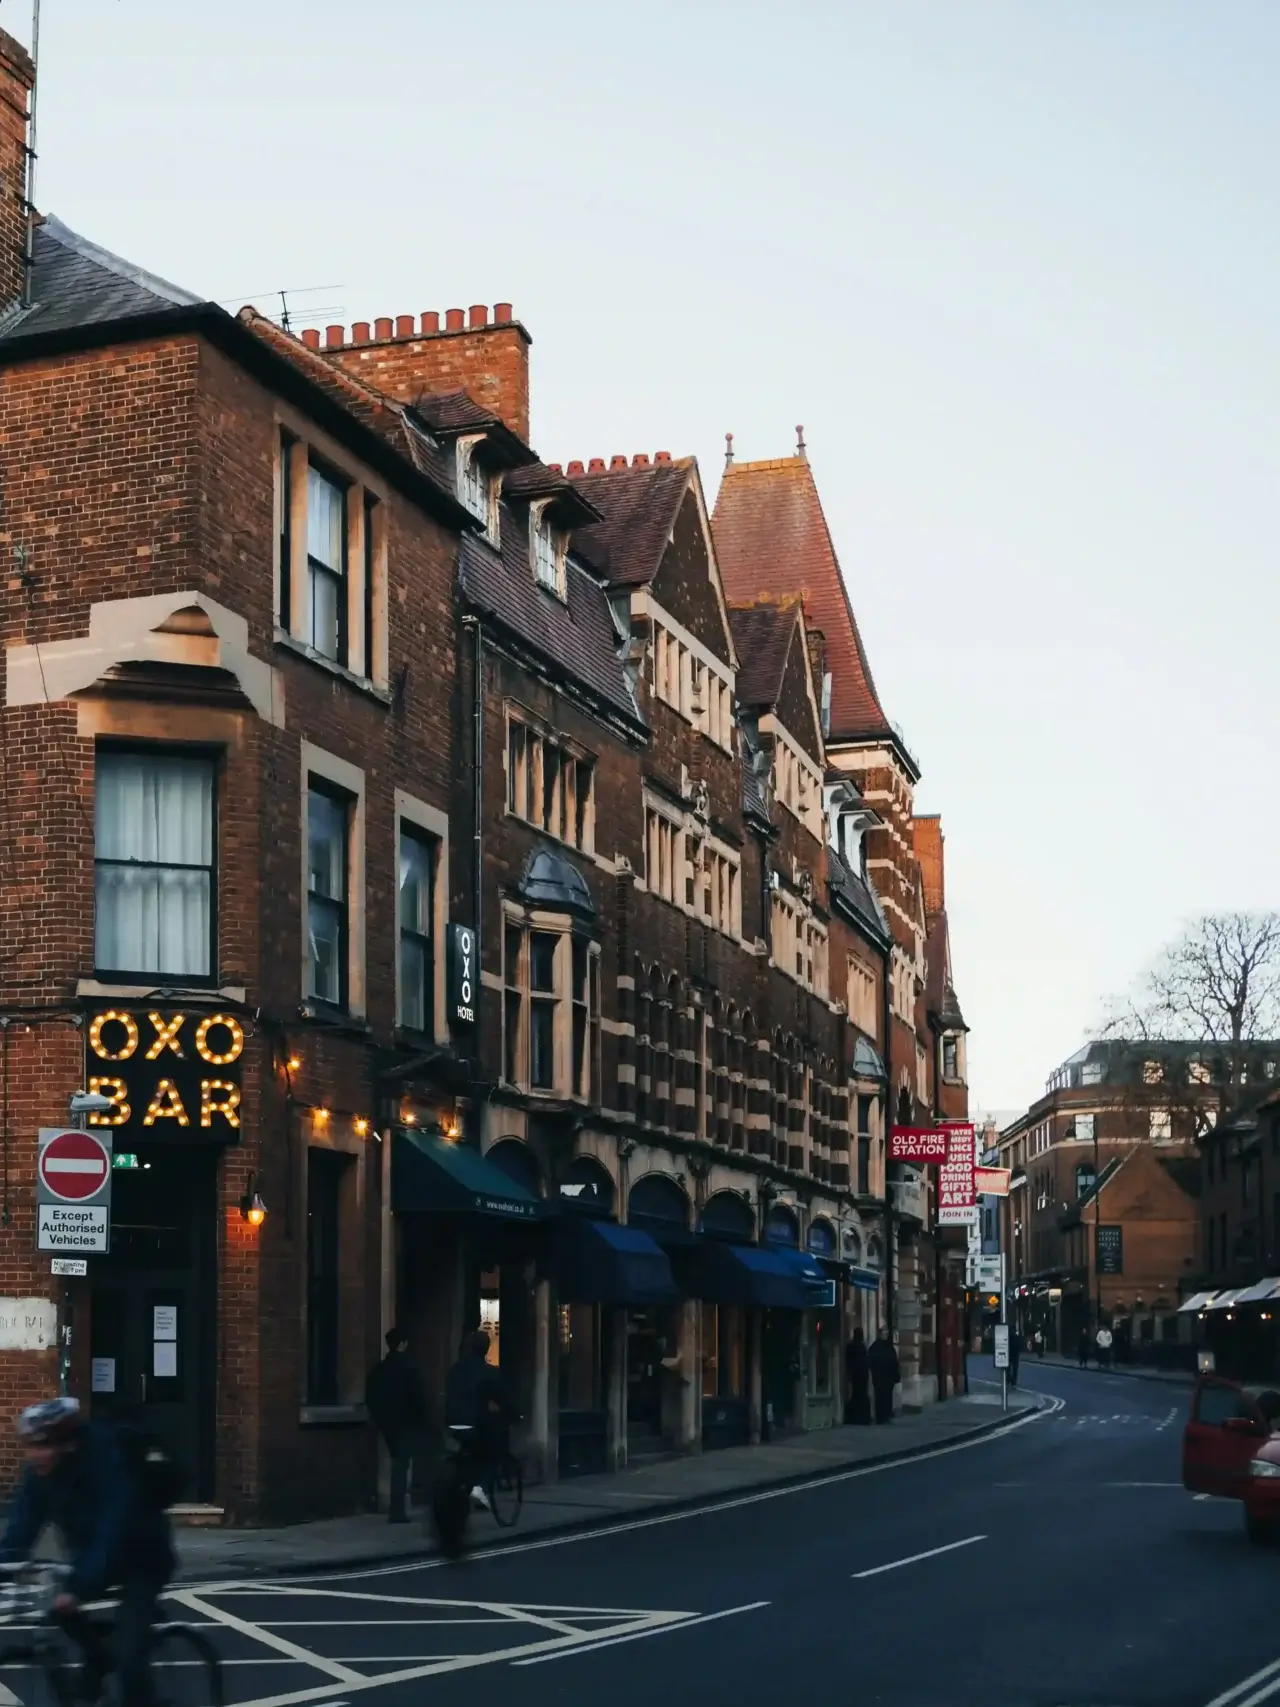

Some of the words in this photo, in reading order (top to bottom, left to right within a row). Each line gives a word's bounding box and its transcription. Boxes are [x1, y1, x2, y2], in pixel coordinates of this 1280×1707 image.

[460, 932, 471, 1003] OXO
[457, 1005, 474, 1022] HOTEL
[89, 1010, 244, 1065] OXO
[88, 1076, 241, 1128] BAR
[892, 1135, 916, 1145] OLD
[920, 1134, 945, 1144] FIRE
[893, 1144, 945, 1155] STATION
[949, 1144, 972, 1152] ANCE
[949, 1153, 972, 1162] USIC
[940, 1173, 972, 1181] DRINK
[941, 1182, 973, 1192] GIFTS
[941, 1192, 973, 1204] ART
[53, 1211, 93, 1222] Except
[42, 1222, 104, 1234] Authorised
[49, 1234, 96, 1246] Vehicles
